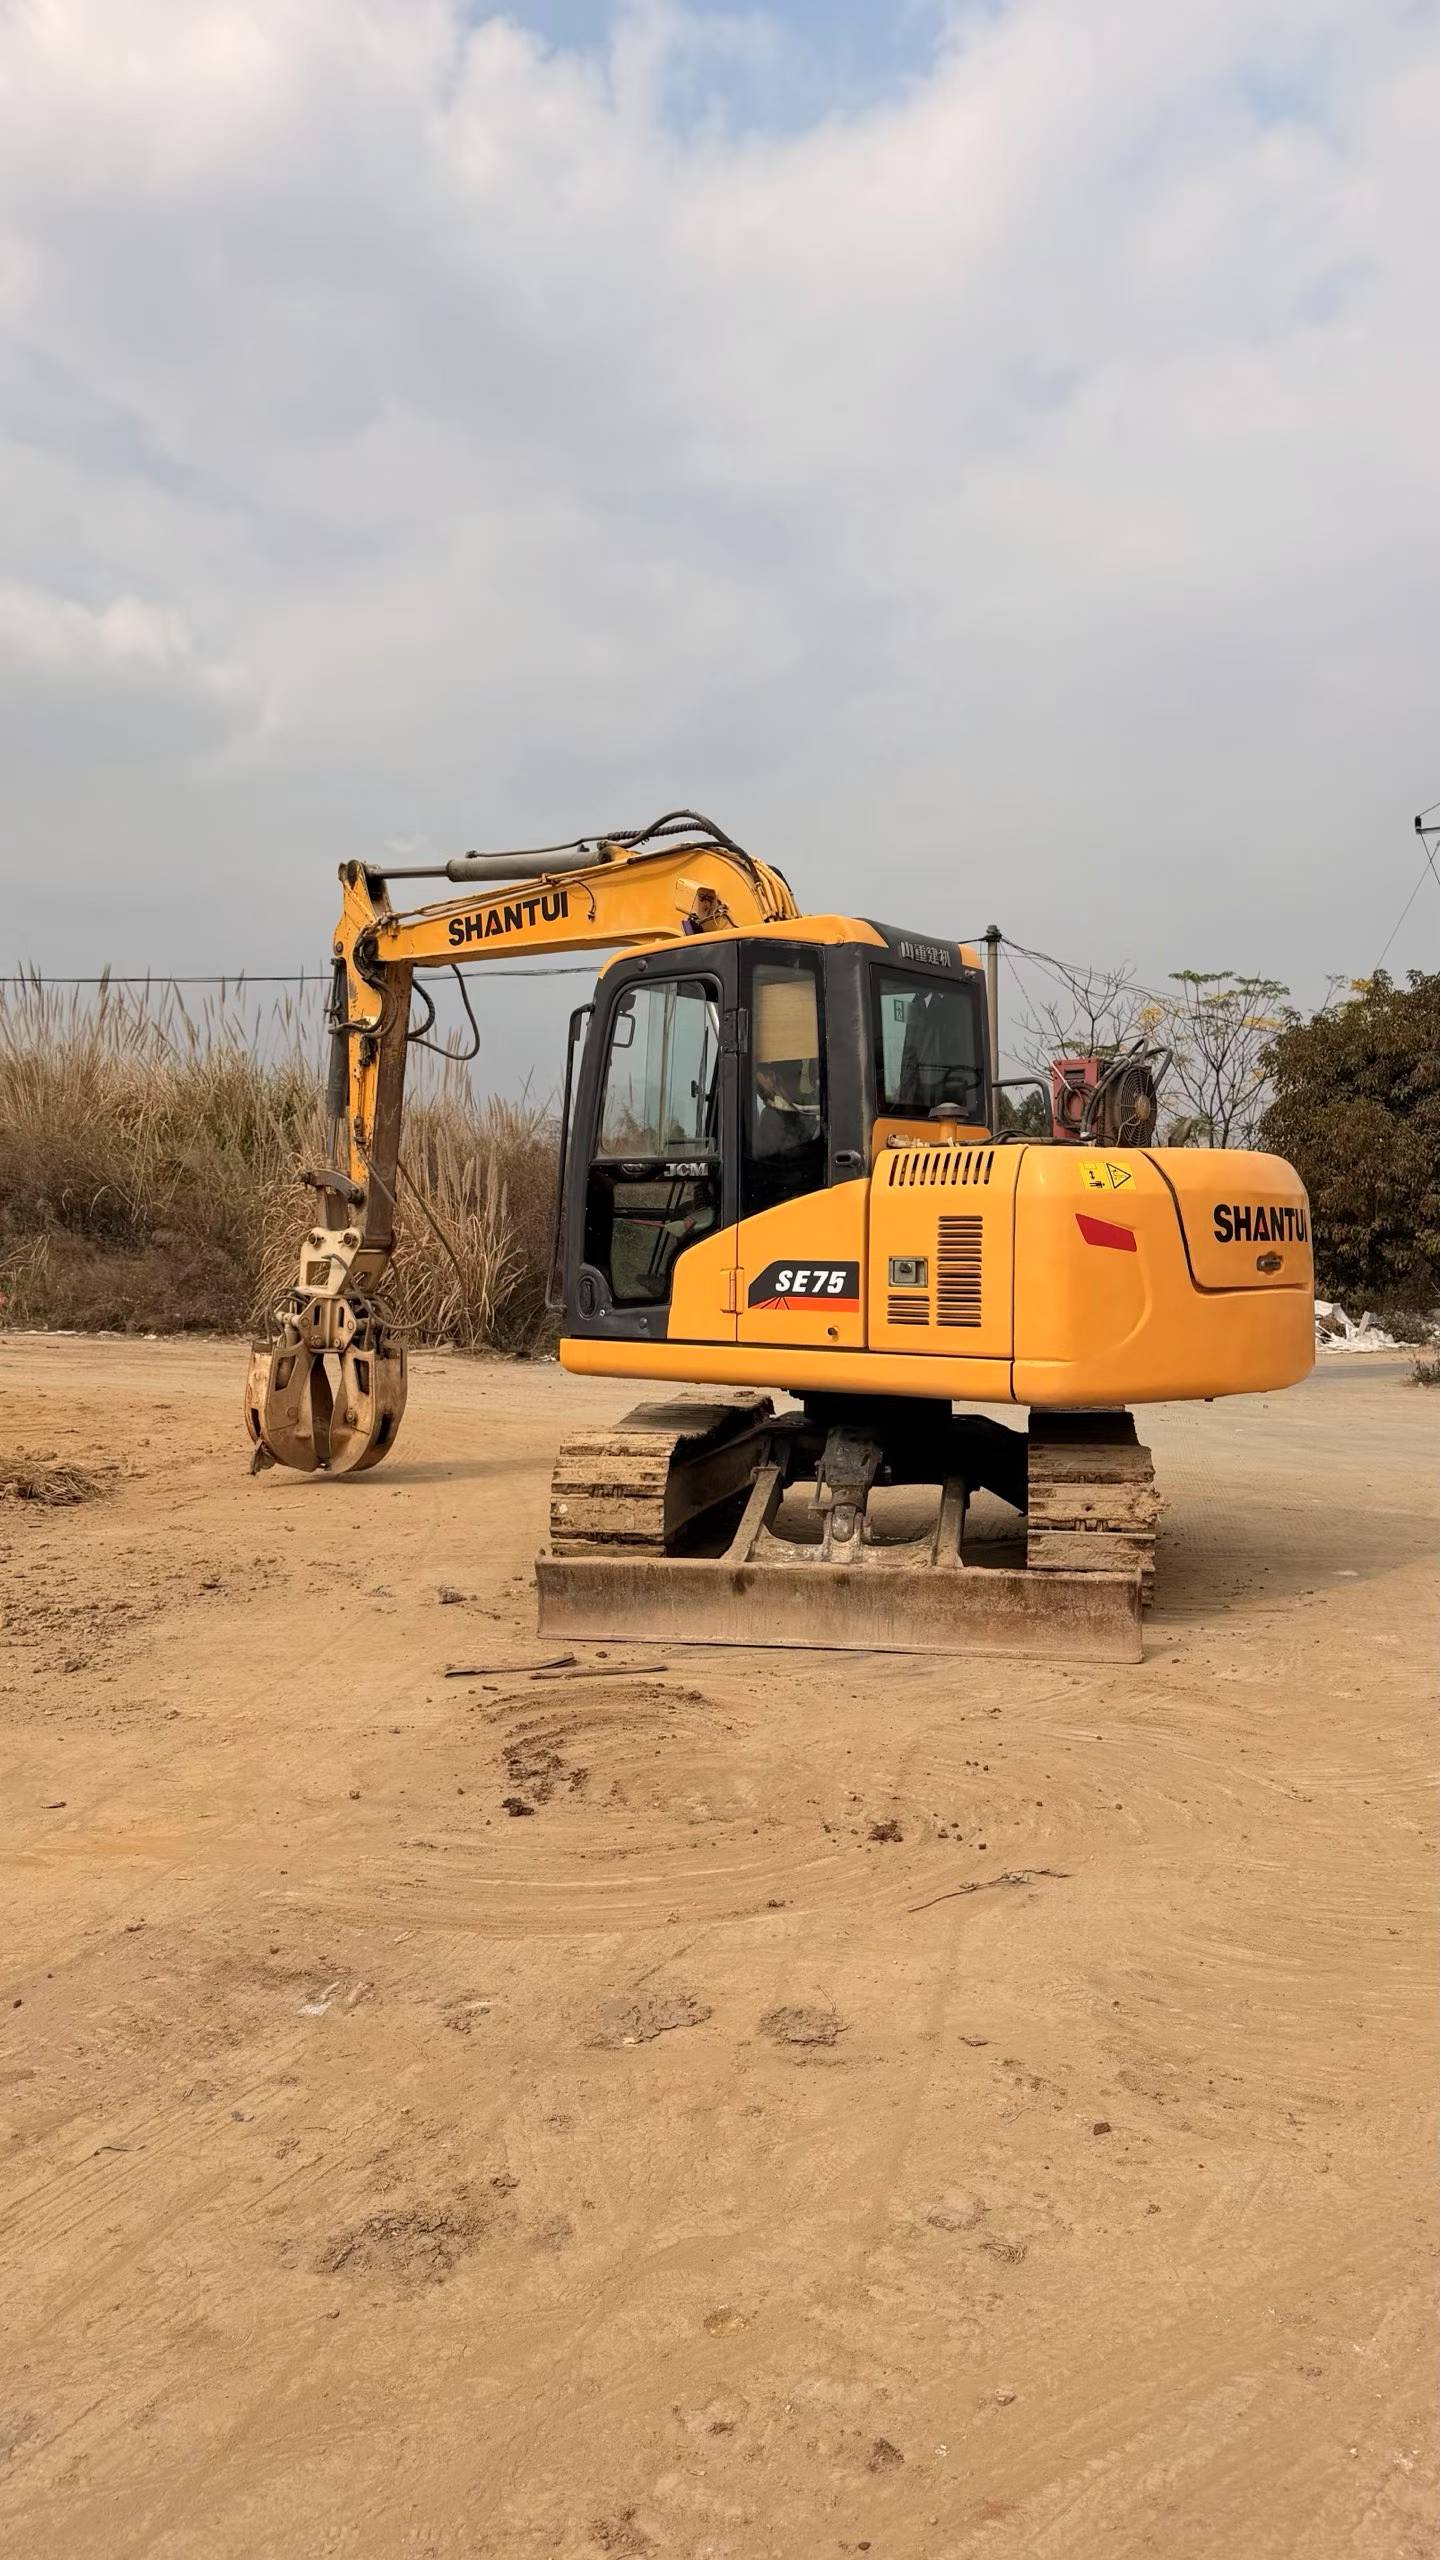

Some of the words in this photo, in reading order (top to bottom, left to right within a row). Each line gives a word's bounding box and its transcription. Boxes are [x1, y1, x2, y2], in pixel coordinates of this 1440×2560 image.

[448, 891, 569, 946] SHANTUI
[663, 1162, 709, 1177] JCM
[775, 1269, 847, 1294] SE75
